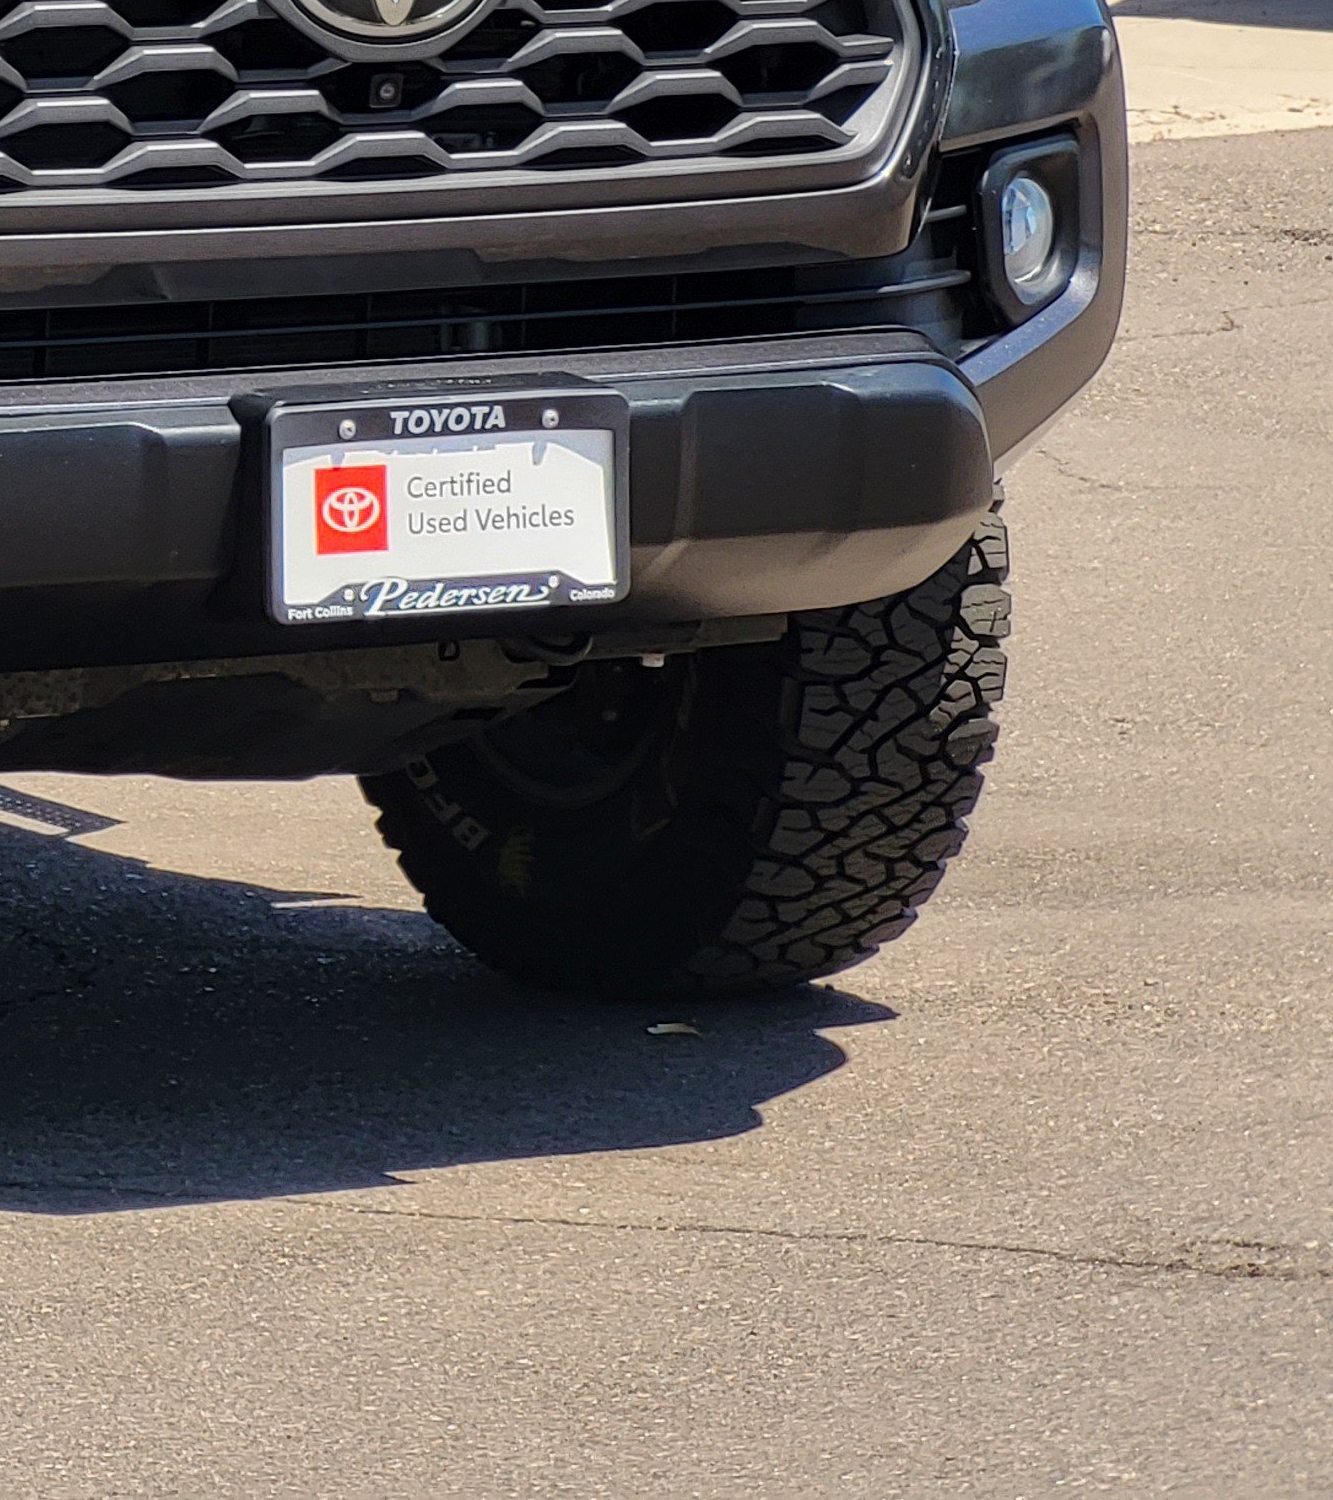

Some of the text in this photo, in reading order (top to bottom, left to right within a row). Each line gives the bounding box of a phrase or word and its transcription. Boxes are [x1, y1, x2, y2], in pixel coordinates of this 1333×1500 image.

[390, 405, 506, 435] TOYOTA
[407, 471, 512, 499] Certified
[408, 503, 575, 534] Used Vehicles
[360, 576, 550, 617] Pedersen
[569, 586, 616, 602] Colorado
[288, 603, 353, 621] Fort Collins
